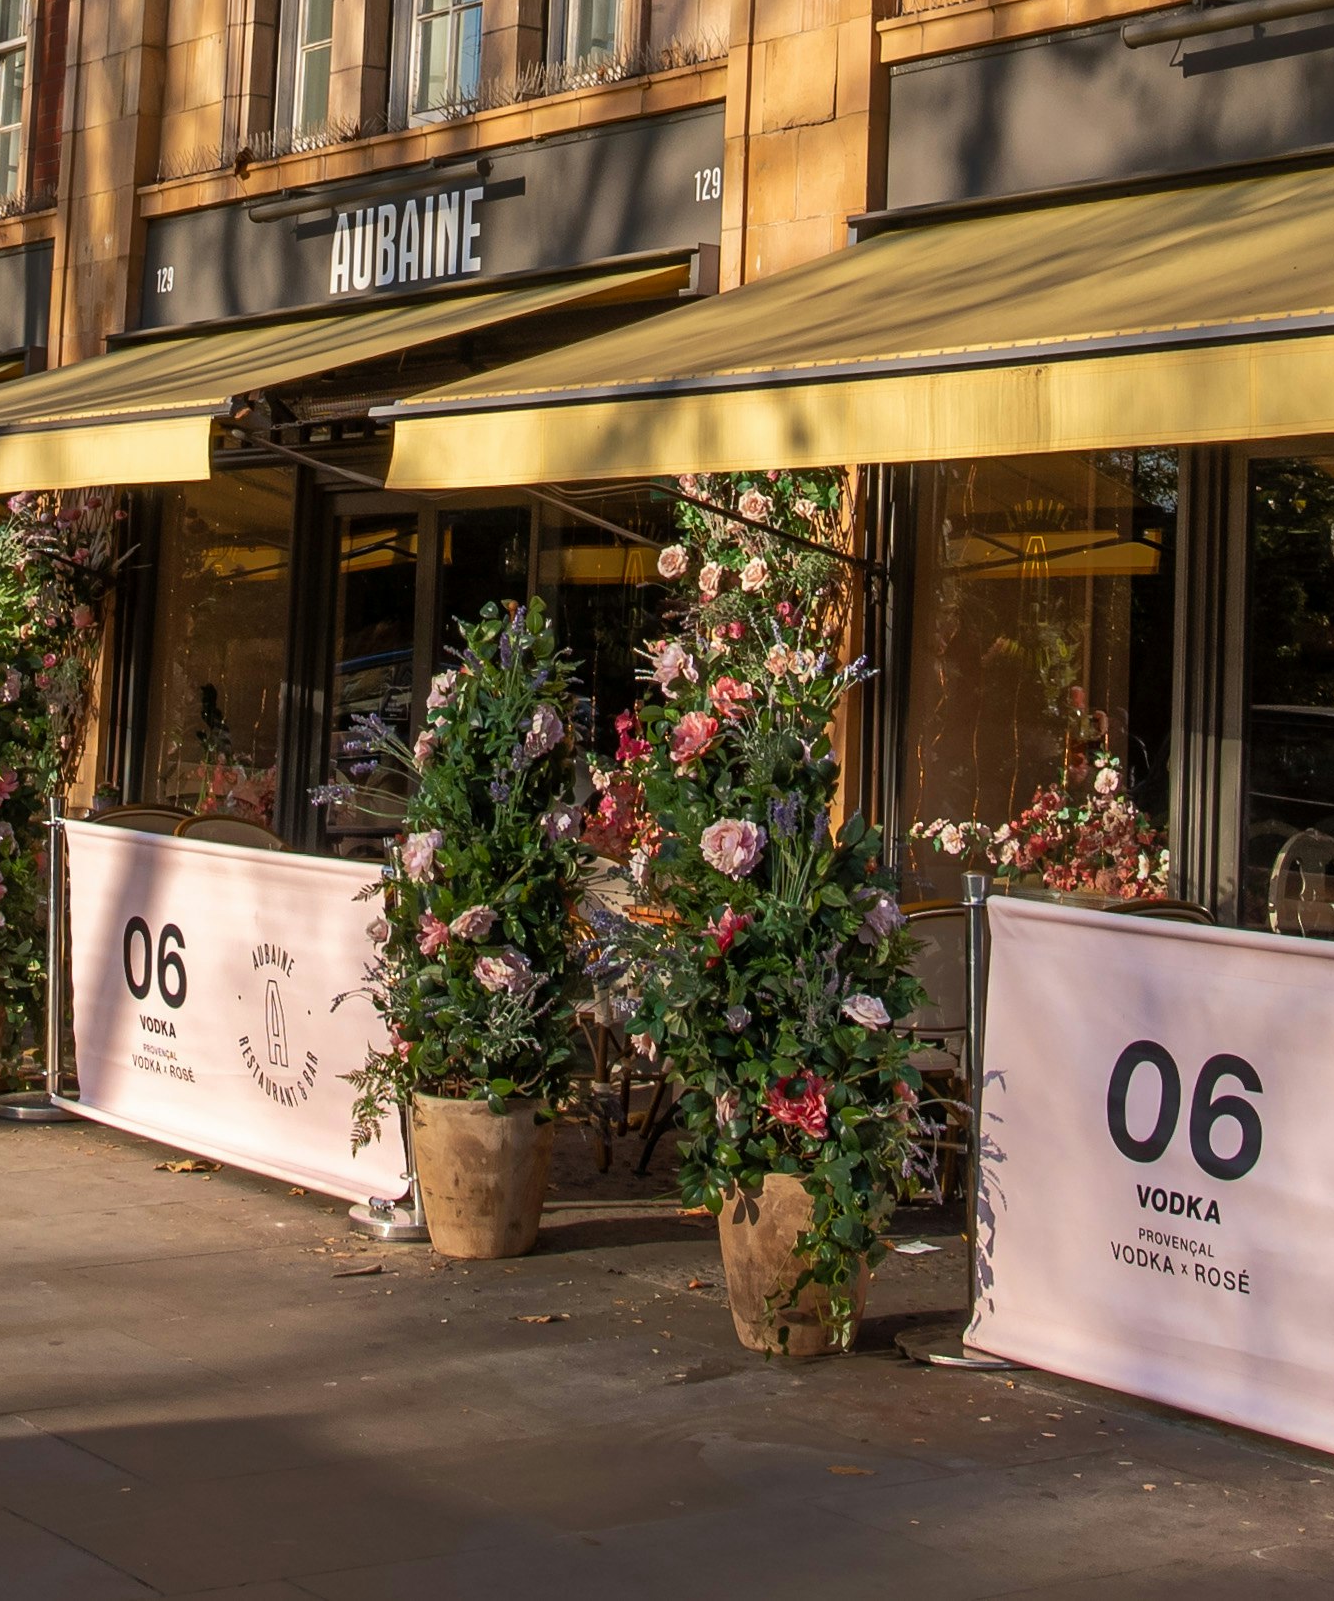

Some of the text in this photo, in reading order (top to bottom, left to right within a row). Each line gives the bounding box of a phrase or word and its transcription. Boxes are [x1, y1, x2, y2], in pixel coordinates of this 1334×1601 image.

[695, 167, 721, 202] 129
[329, 186, 484, 294] AUBAINE
[156, 266, 174, 293] 129
[123, 915, 188, 1010] 06
[251, 943, 295, 978] AUBAINE
[139, 1014, 176, 1039] VODKA
[132, 1054, 162, 1075] VODKA
[169, 1064, 196, 1084] ROSÉ
[143, 1043, 178, 1061] PROVENÇAL
[238, 1035, 319, 1108] RESTAURANT & BAR
[1107, 1039, 1264, 1181] 06
[1136, 1184, 1222, 1226] VODKA
[1138, 1227, 1216, 1259] PROVENÇAL
[1111, 1240, 1176, 1276] VODKA
[1194, 1269, 1251, 1295] ROSÉ
